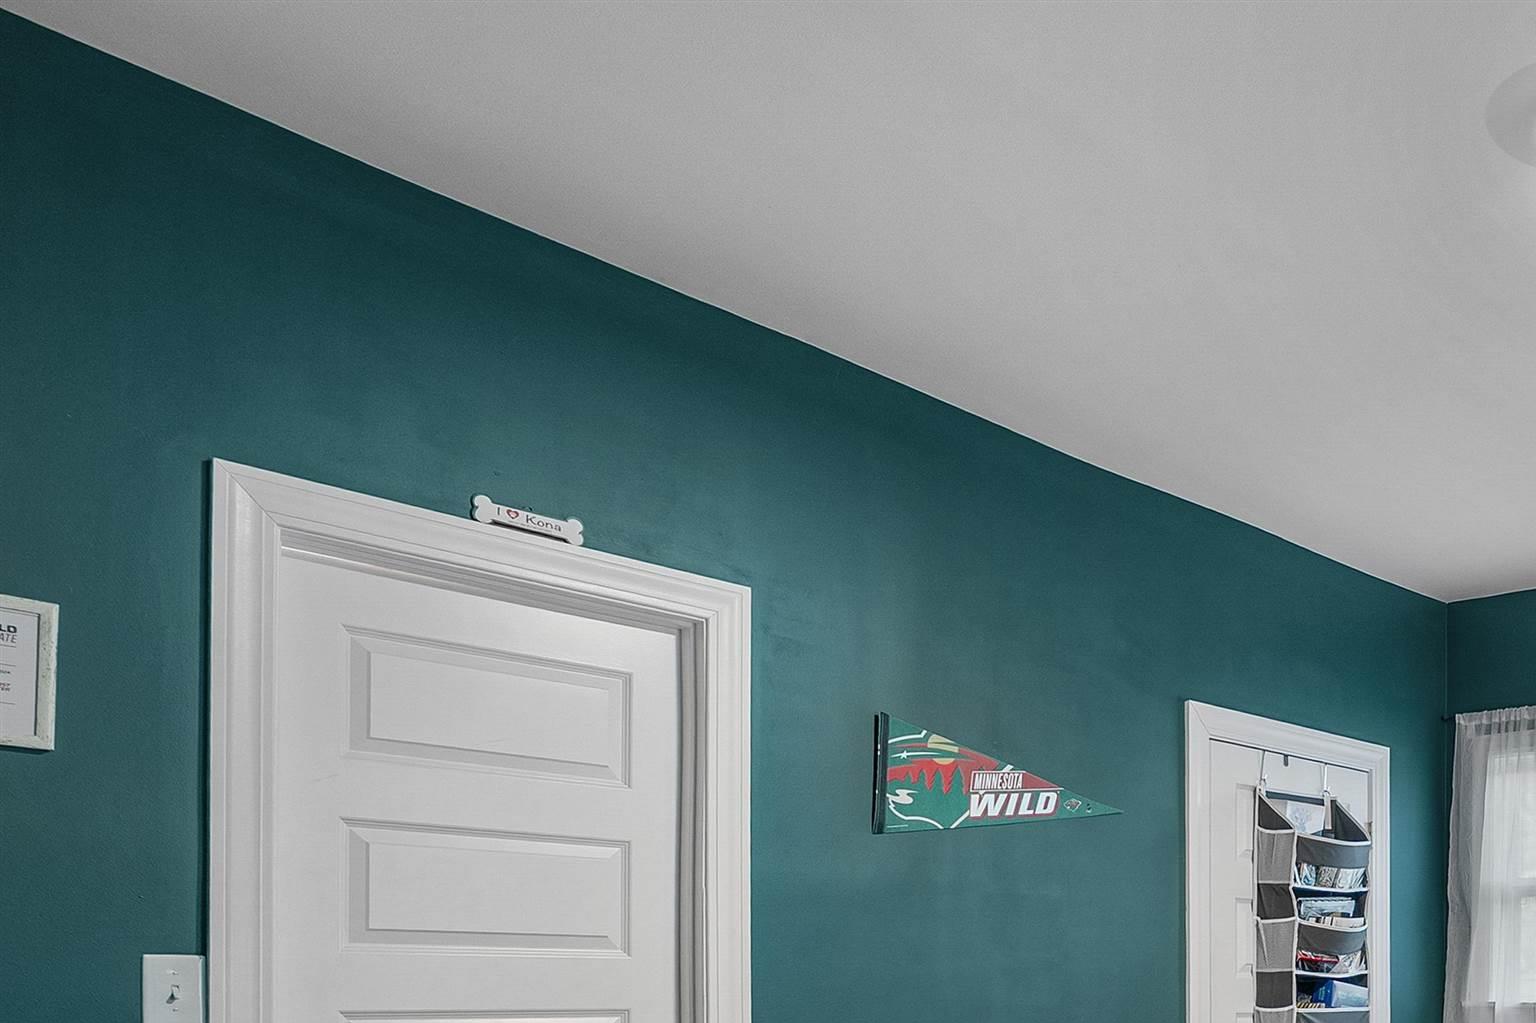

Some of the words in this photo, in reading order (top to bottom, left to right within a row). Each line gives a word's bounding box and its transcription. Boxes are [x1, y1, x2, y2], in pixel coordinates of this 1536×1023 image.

[525, 514, 562, 532] Kona
[973, 773, 1023, 790] MINNESOTA
[970, 791, 1059, 817] WILD
